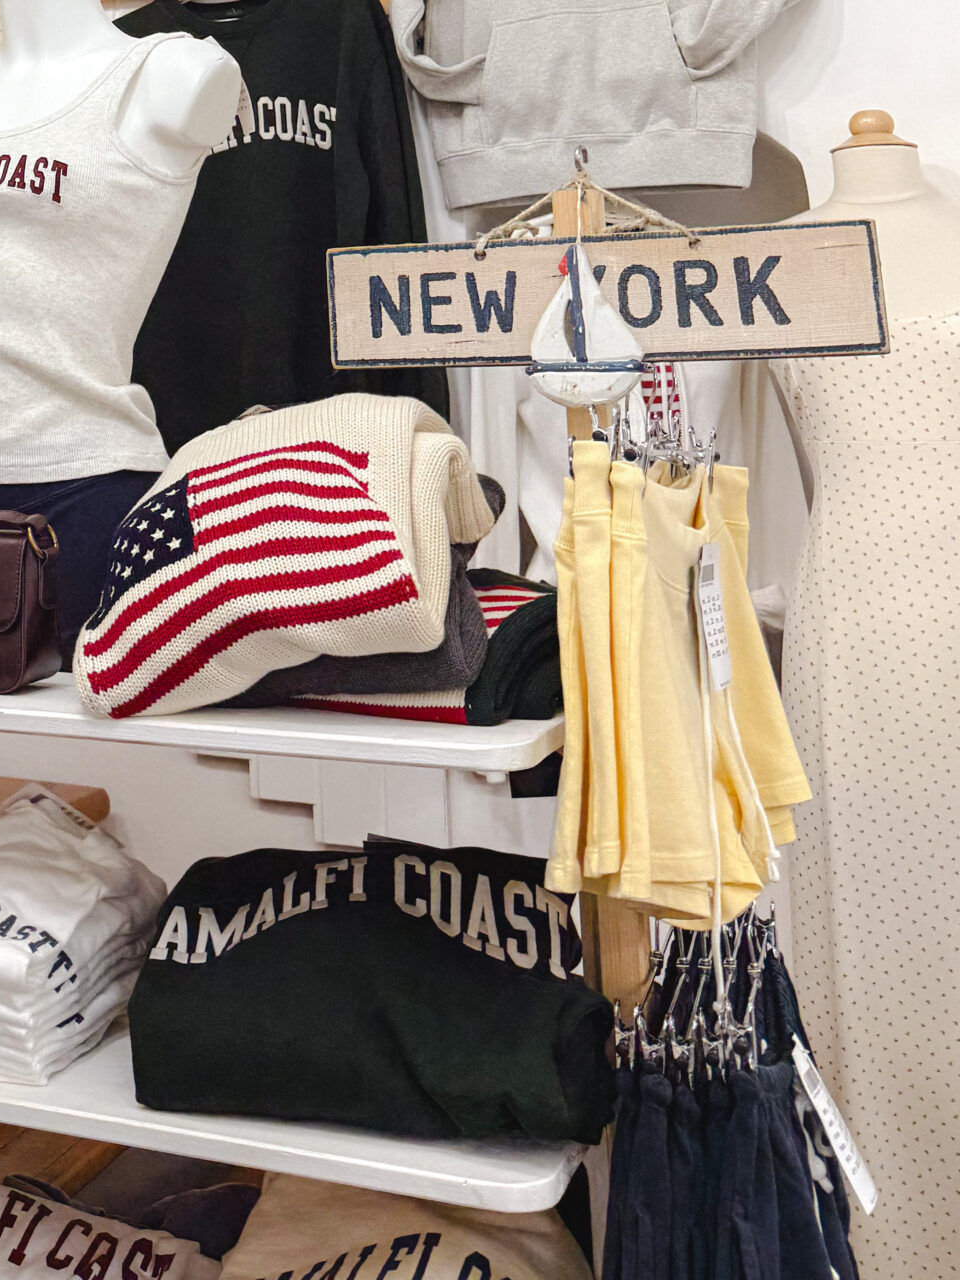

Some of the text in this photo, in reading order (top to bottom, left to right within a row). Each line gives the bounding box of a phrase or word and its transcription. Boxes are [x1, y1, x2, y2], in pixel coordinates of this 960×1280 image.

[257, 96, 337, 151] COAS
[369, 255, 792, 339] NEW ORK
[149, 853, 569, 980] AMALFI COAST
